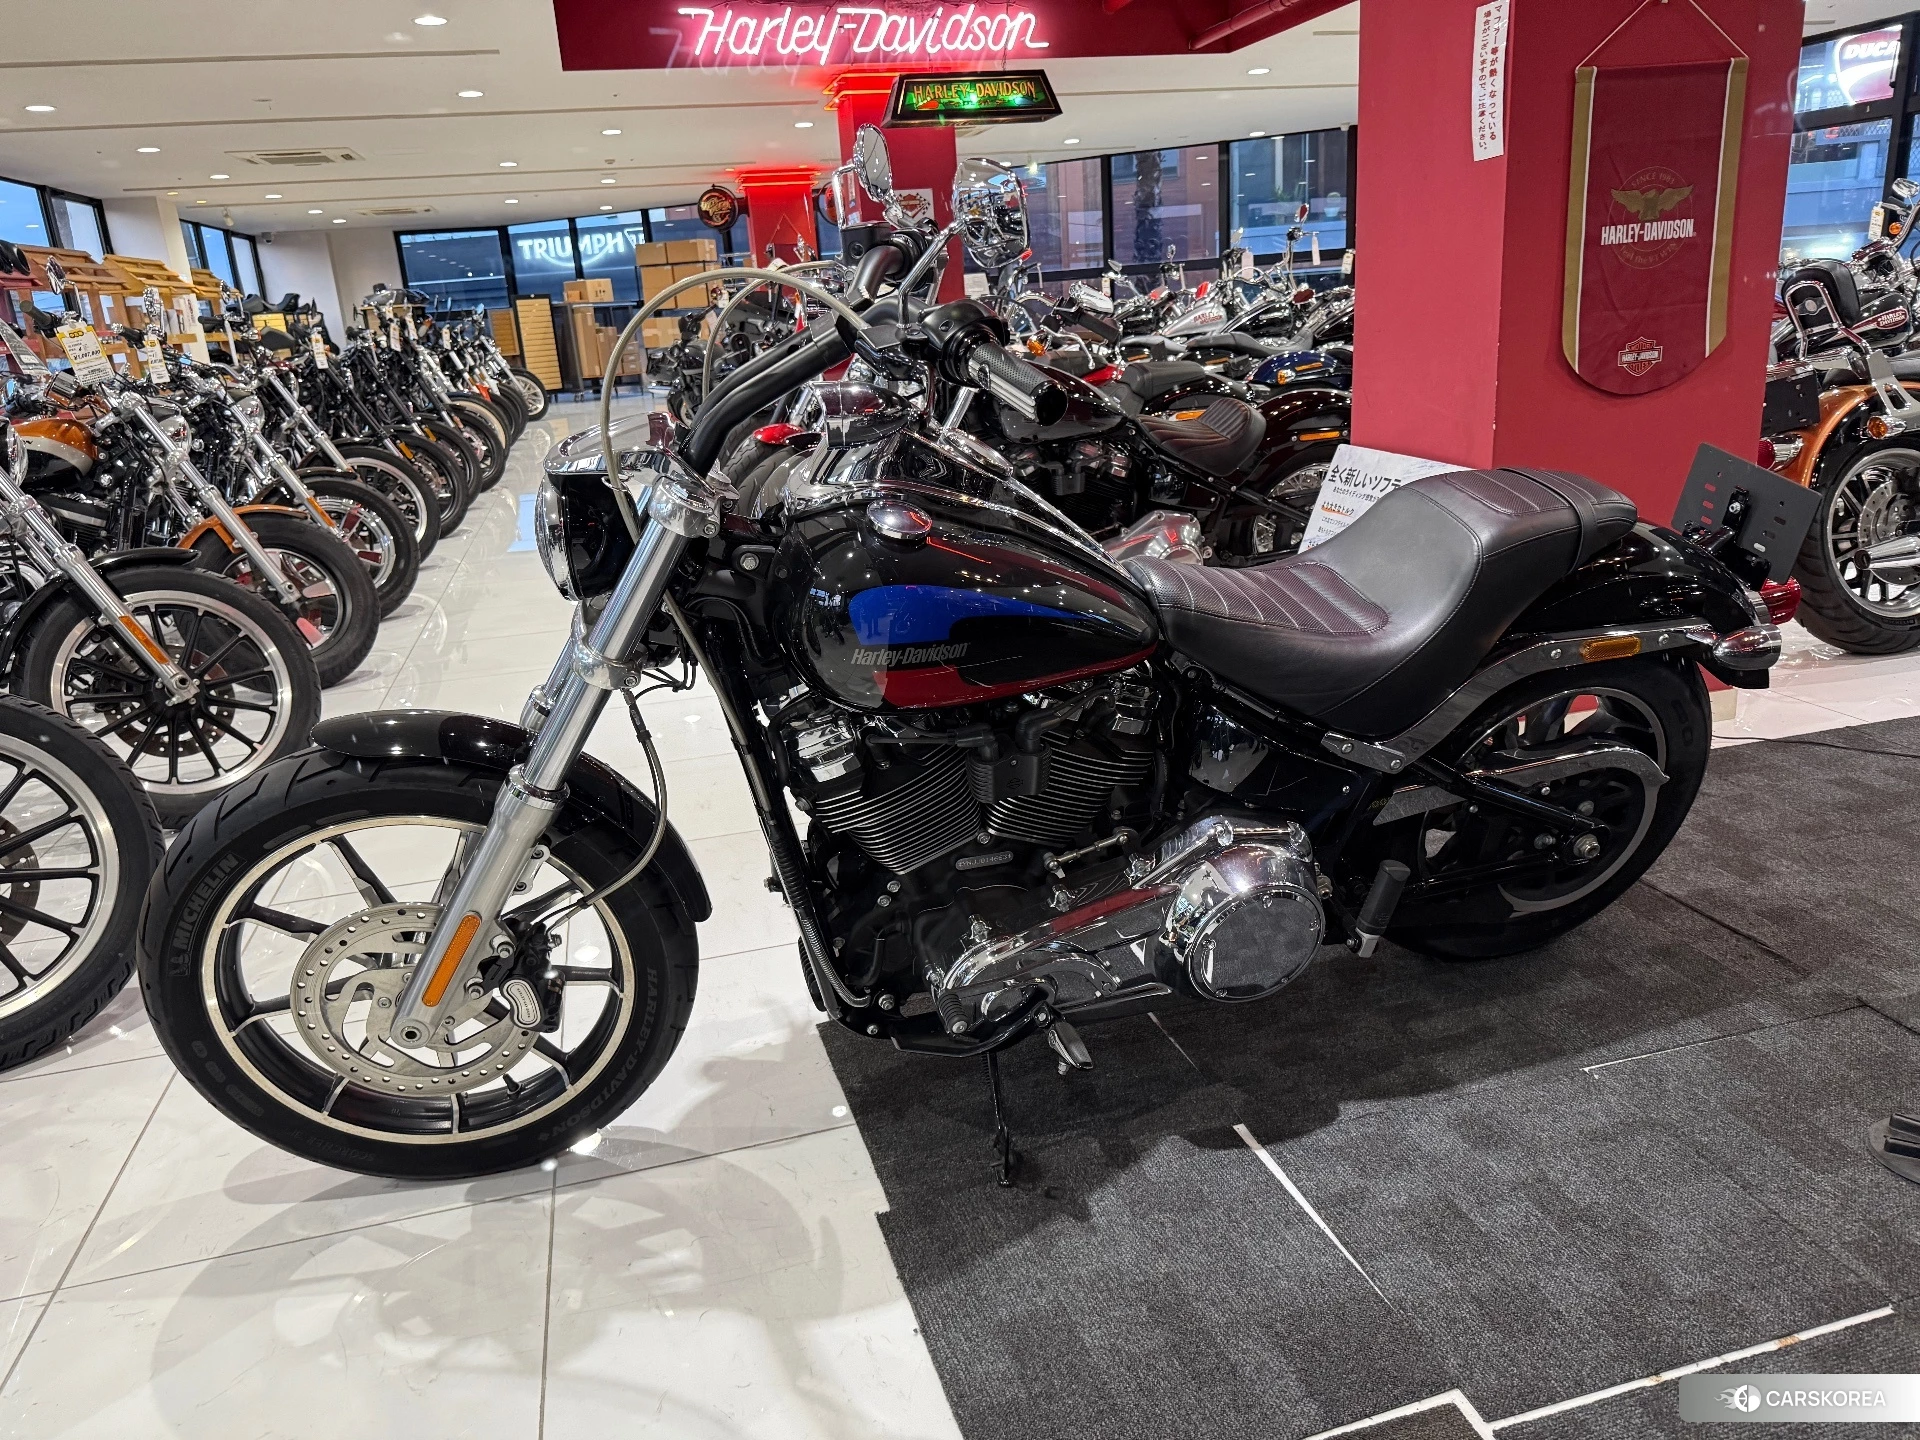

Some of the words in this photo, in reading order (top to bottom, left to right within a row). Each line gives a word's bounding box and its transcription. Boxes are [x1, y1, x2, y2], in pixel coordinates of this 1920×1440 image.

[678, 7, 1049, 65] Harley-Davidson
[1488, 4, 1503, 141] マフラー等が熱くなっている
[913, 81, 1036, 101] HARLEY-DAVIDSON
[517, 231, 625, 264] TRIUMPH
[1601, 219, 1694, 245] HARLEY-DAVIDSON
[851, 643, 968, 668] Harley-Davidson
[172, 852, 240, 951] MICHELIN
